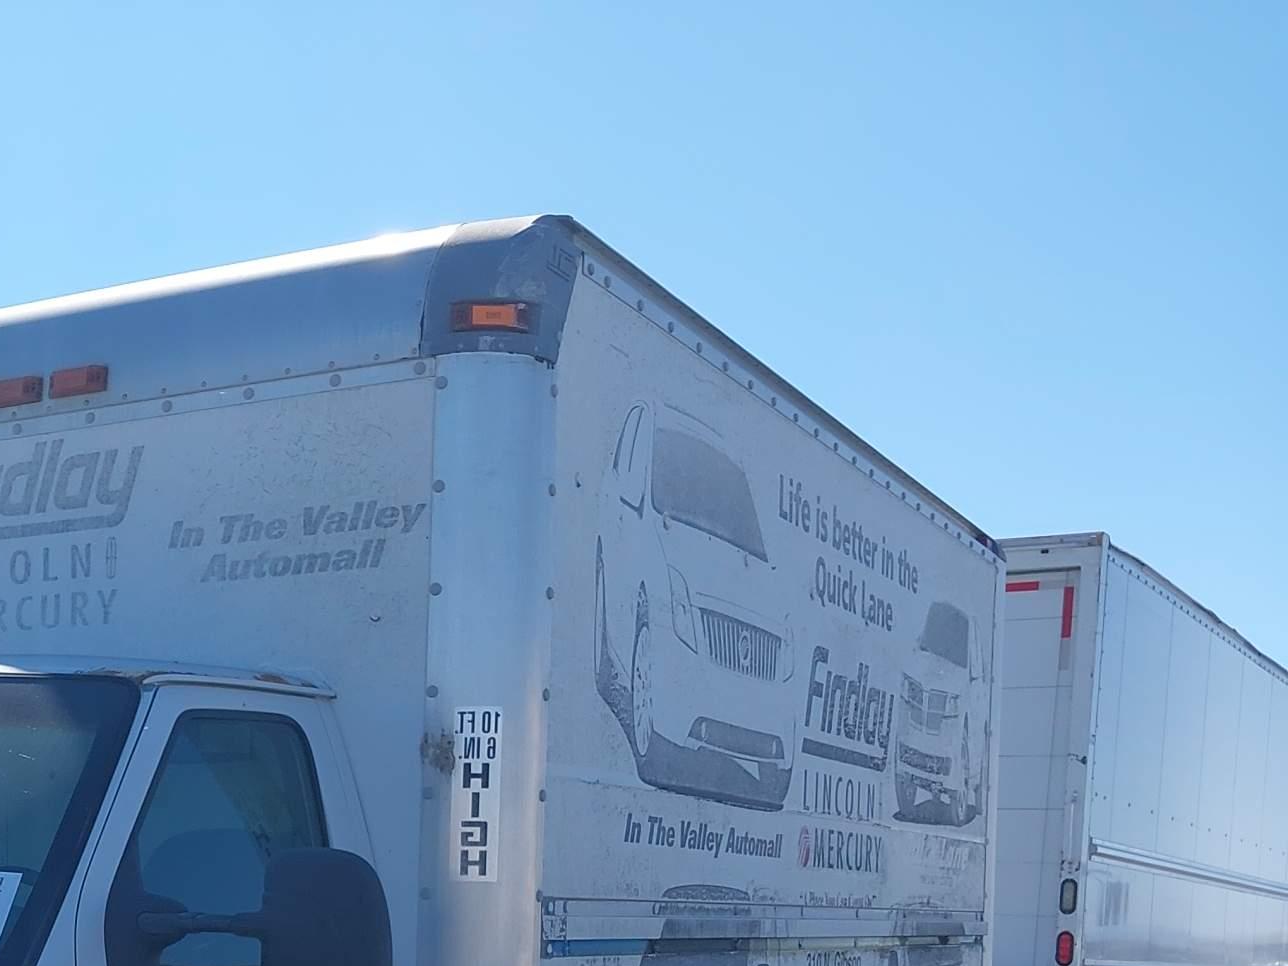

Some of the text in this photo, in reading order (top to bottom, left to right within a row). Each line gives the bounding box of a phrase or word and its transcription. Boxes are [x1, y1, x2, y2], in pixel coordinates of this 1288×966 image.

[167, 500, 427, 549] In The Valley
[778, 473, 918, 594] Life is better in the
[200, 539, 386, 583] Automall
[815, 556, 893, 632] Quick Lane
[804, 645, 895, 755] Findlay
[801, 769, 875, 822] LINCOLN
[624, 813, 783, 858] In The Valley Automall
[812, 827, 882, 874] MERCURY
